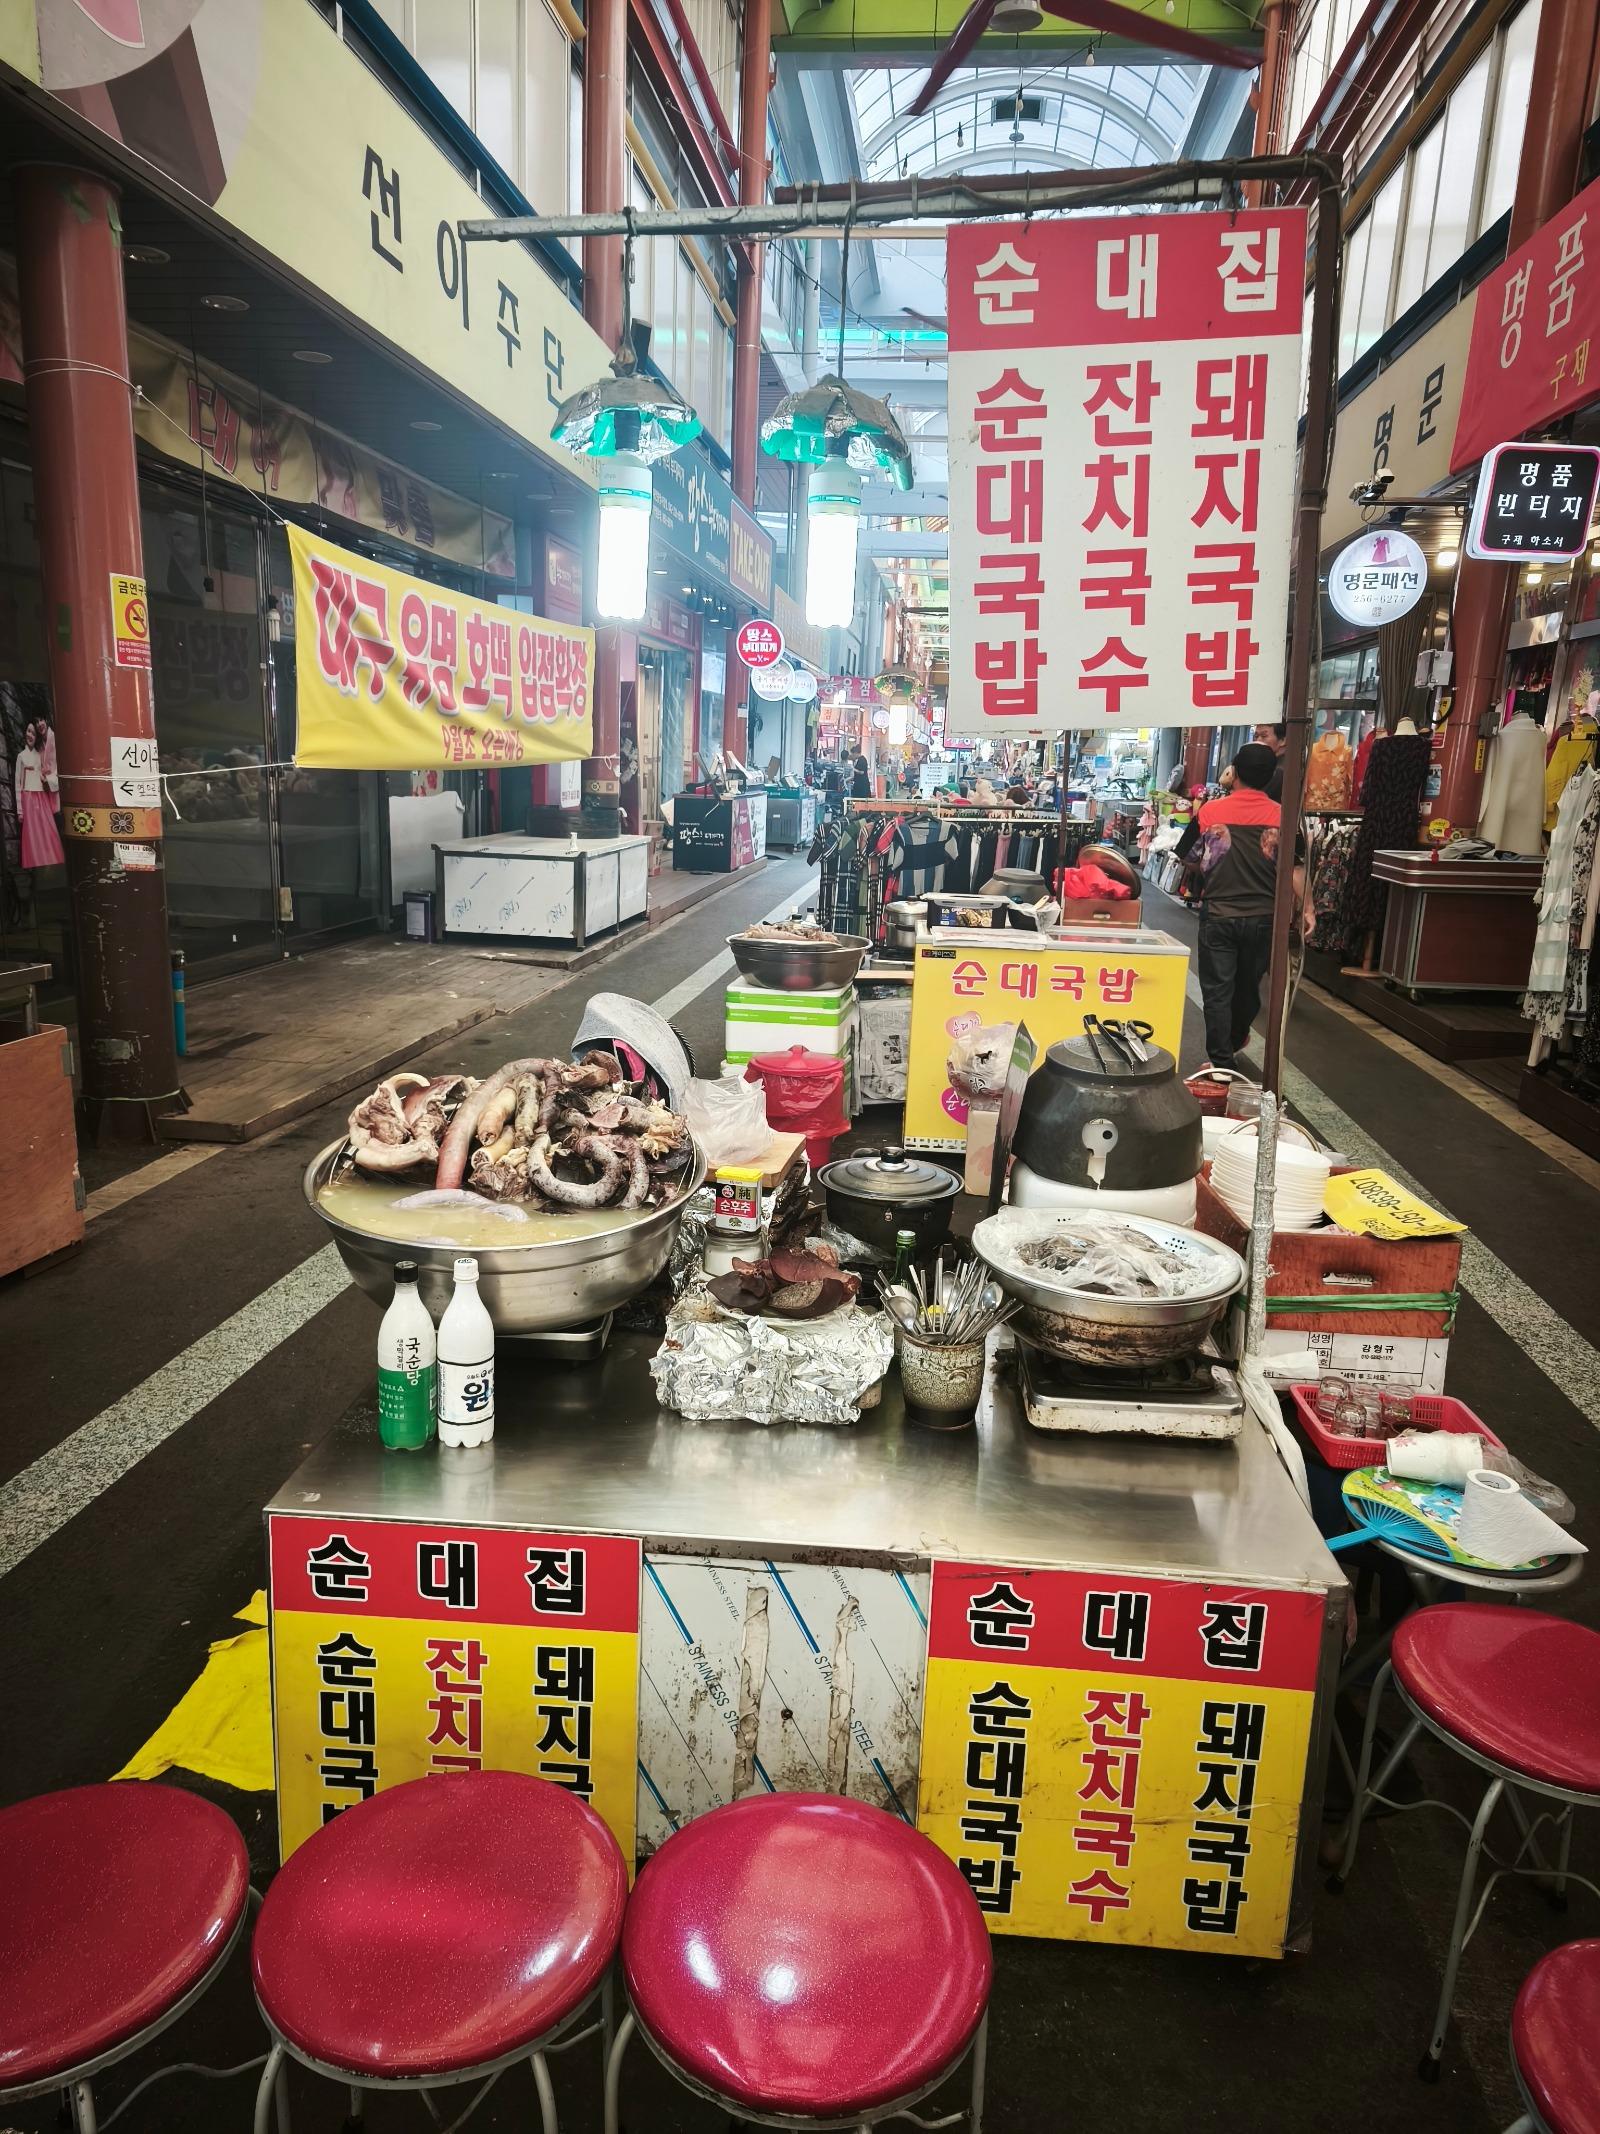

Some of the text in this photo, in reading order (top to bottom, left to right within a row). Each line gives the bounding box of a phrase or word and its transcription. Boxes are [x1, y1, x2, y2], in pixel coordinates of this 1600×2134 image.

[973, 227, 1281, 326] 순대집
[1500, 212, 1588, 369] 명품
[1551, 339, 1591, 400] 구제
[1519, 463, 1573, 488] 명품
[1077, 360, 1162, 713] 잔치국수
[1184, 353, 1269, 708] 돼지국밥
[1497, 493, 1583, 520] 빈티지
[732, 521, 771, 594] TAKE OUT
[973, 367, 1048, 717] 순대국밥
[1501, 534, 1564, 548] 구제 하소서
[118, 580, 146, 597] 금연구
[1343, 572, 1418, 591] 명문패션
[310, 559, 395, 697] 대구
[400, 594, 459, 712] 유명
[462, 613, 513, 720] 호떡
[746, 629, 773, 642] 땅스
[952, 960, 1139, 1003] 순대국밥
[720, 1200, 751, 1214] 순후추
[405, 1337, 422, 1386] 국순당
[1311, 1333, 1331, 1344] 성명
[307, 1534, 587, 1616] 순대집
[966, 1581, 1268, 1672] 순대집
[689, 1646, 730, 1707] STAINLESS
[849, 1720, 876, 1758] STEEL
[958, 1680, 1033, 1915] 순대국밥
[1066, 1689, 1152, 1924] 잔치국수
[1182, 1700, 1267, 1936] 돼지국밥
